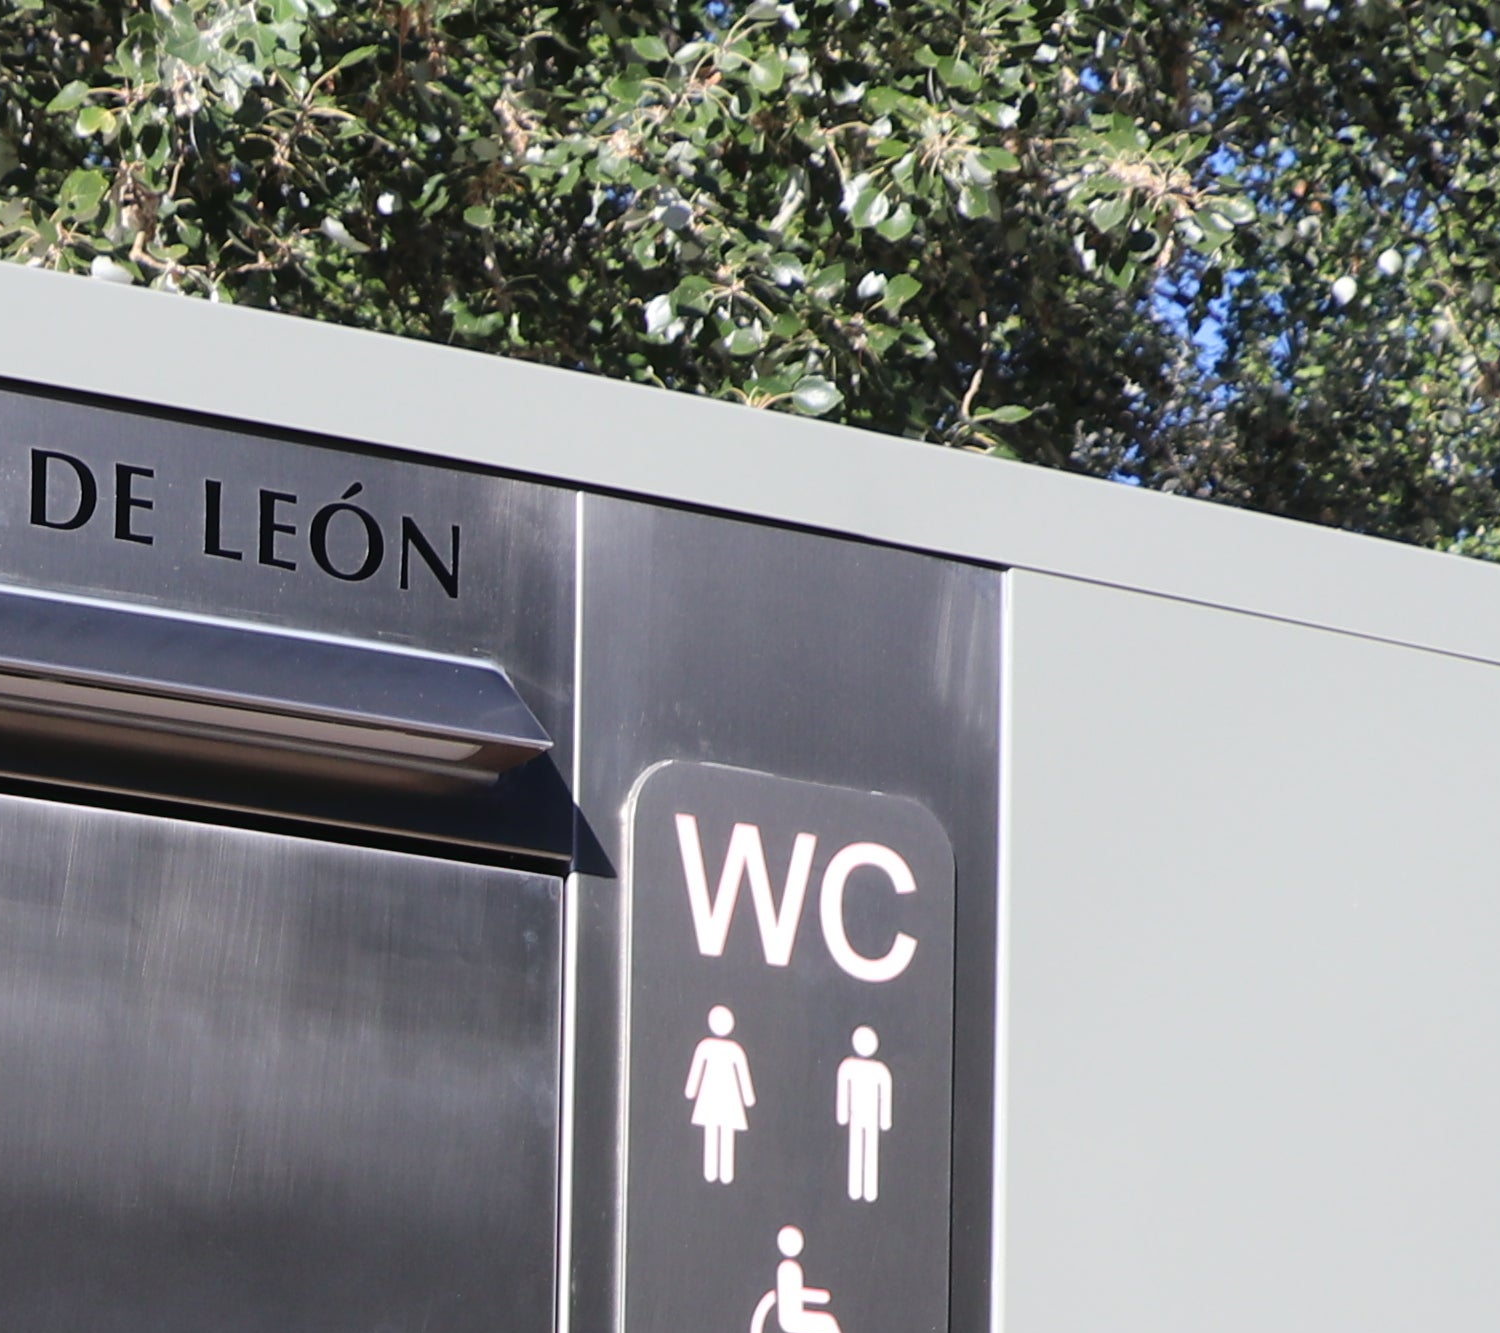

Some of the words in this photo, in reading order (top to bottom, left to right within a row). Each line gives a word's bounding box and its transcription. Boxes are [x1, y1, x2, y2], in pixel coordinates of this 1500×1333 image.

[29, 447, 155, 546] DE
[203, 479, 461, 599] LEÓN
[675, 812, 918, 983] WC
